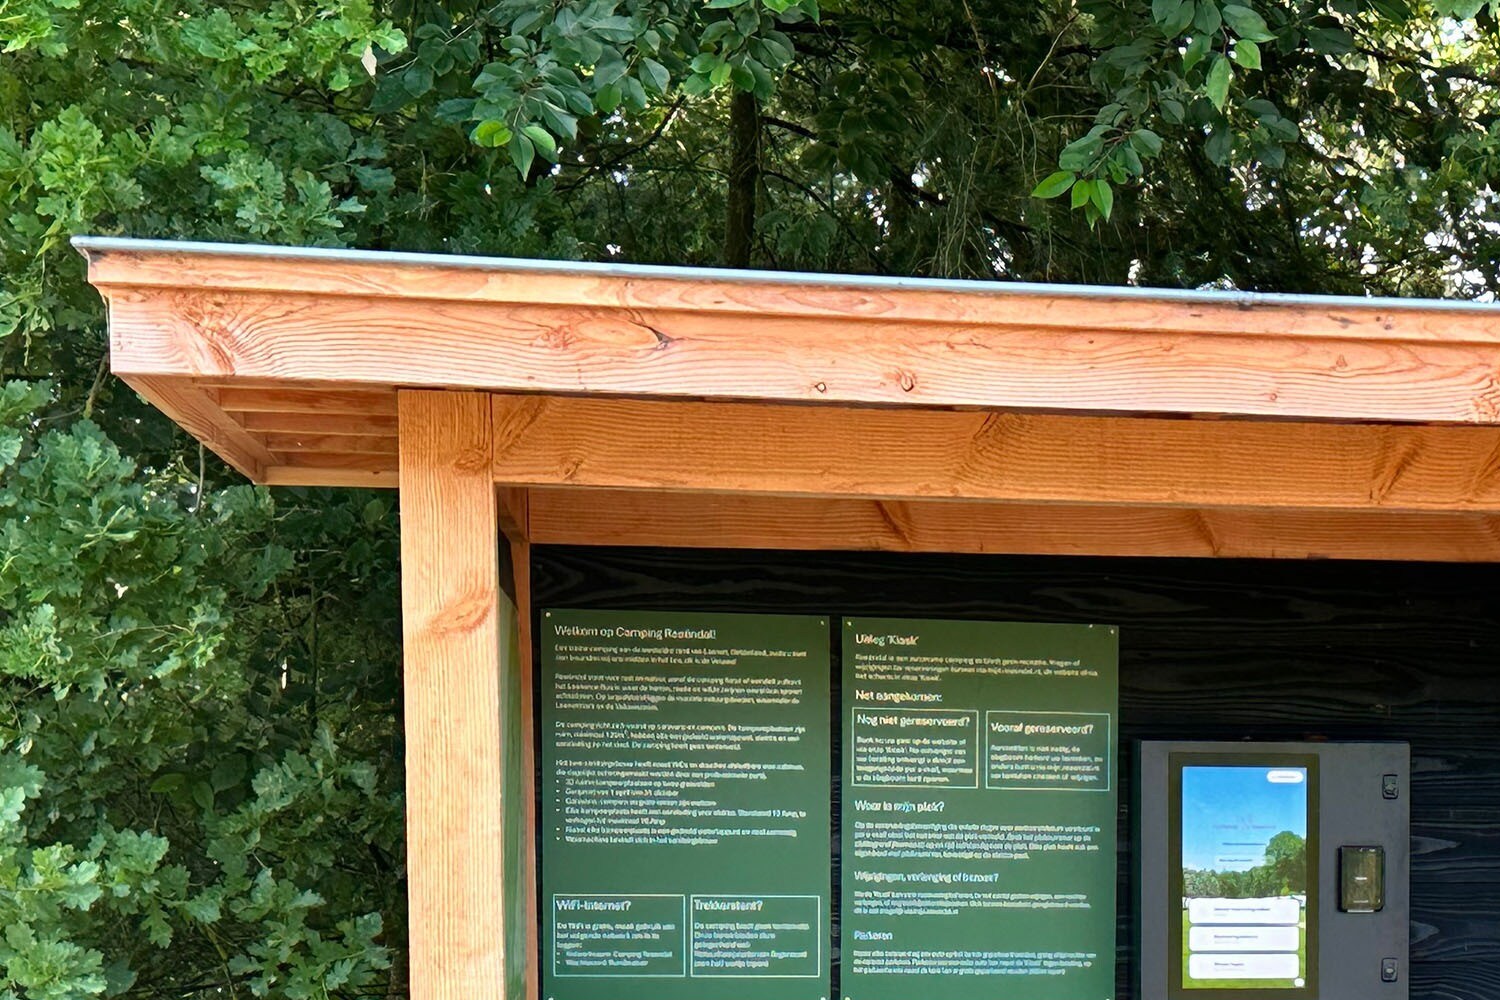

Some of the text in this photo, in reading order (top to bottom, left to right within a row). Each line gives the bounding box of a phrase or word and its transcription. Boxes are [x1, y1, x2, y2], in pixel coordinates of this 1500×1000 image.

[555, 625, 598, 636] Welkom
[600, 628, 613, 637] op
[616, 627, 663, 640] Camping
[856, 690, 873, 700] Net
[857, 714, 970, 727] Nog niet gereserveerd?
[991, 723, 1093, 734] Vooraf gereserveerd?
[855, 800, 881, 810] Waar
[883, 802, 892, 810] is
[917, 802, 944, 812] plek?
